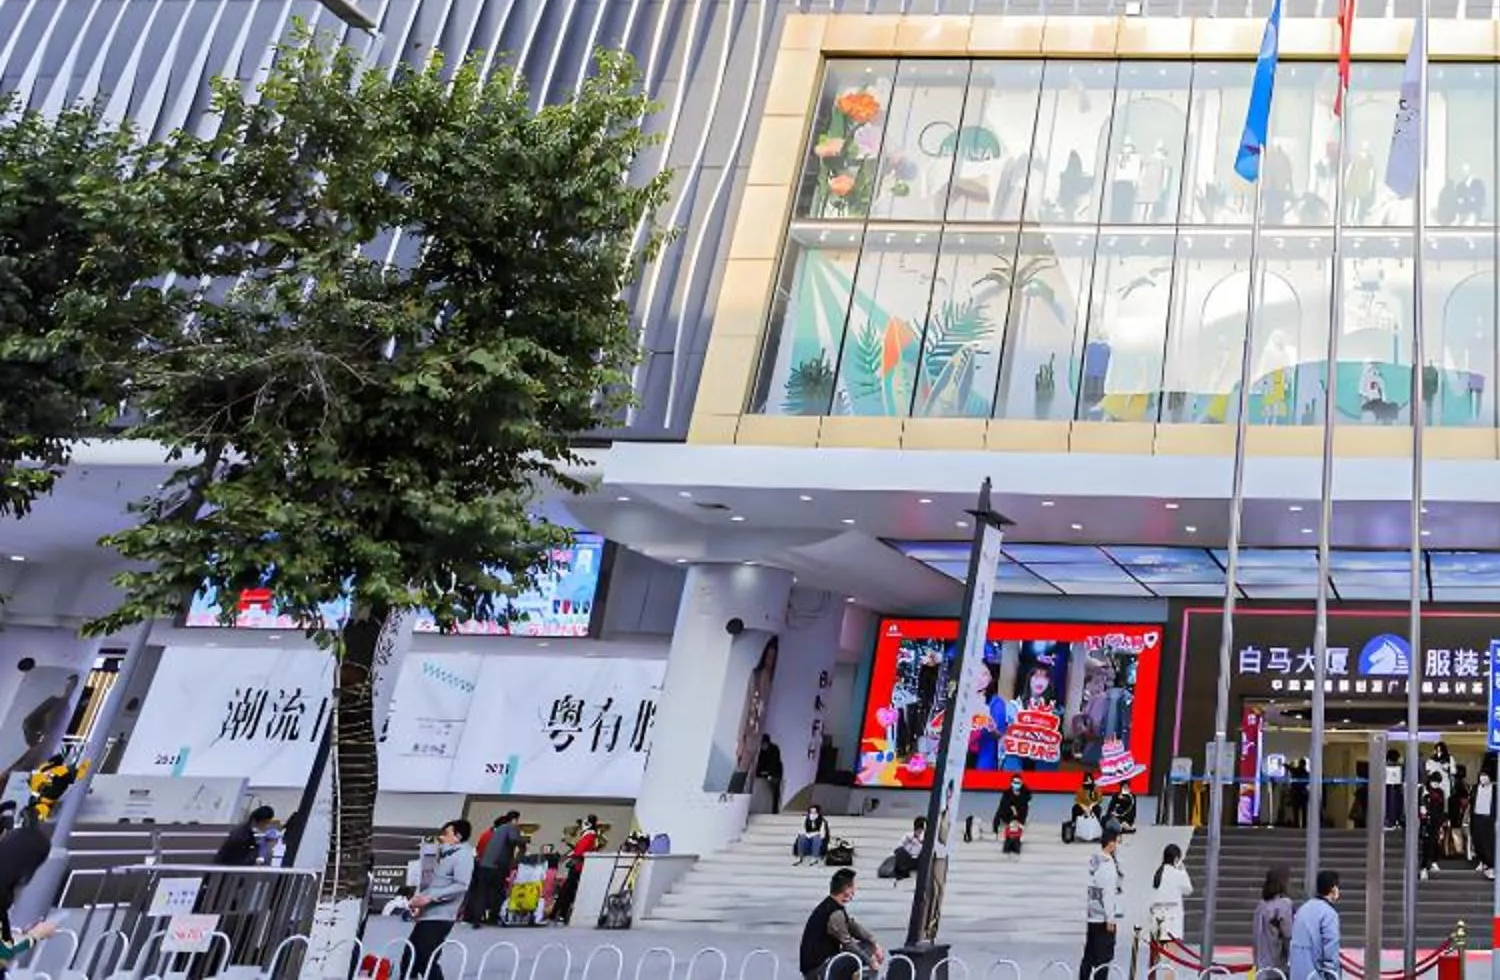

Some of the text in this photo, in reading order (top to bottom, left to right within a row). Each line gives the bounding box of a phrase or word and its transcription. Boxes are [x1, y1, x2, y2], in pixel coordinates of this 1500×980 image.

[1239, 646, 1349, 674] 白马大厦
[217, 686, 328, 743] 潮流
